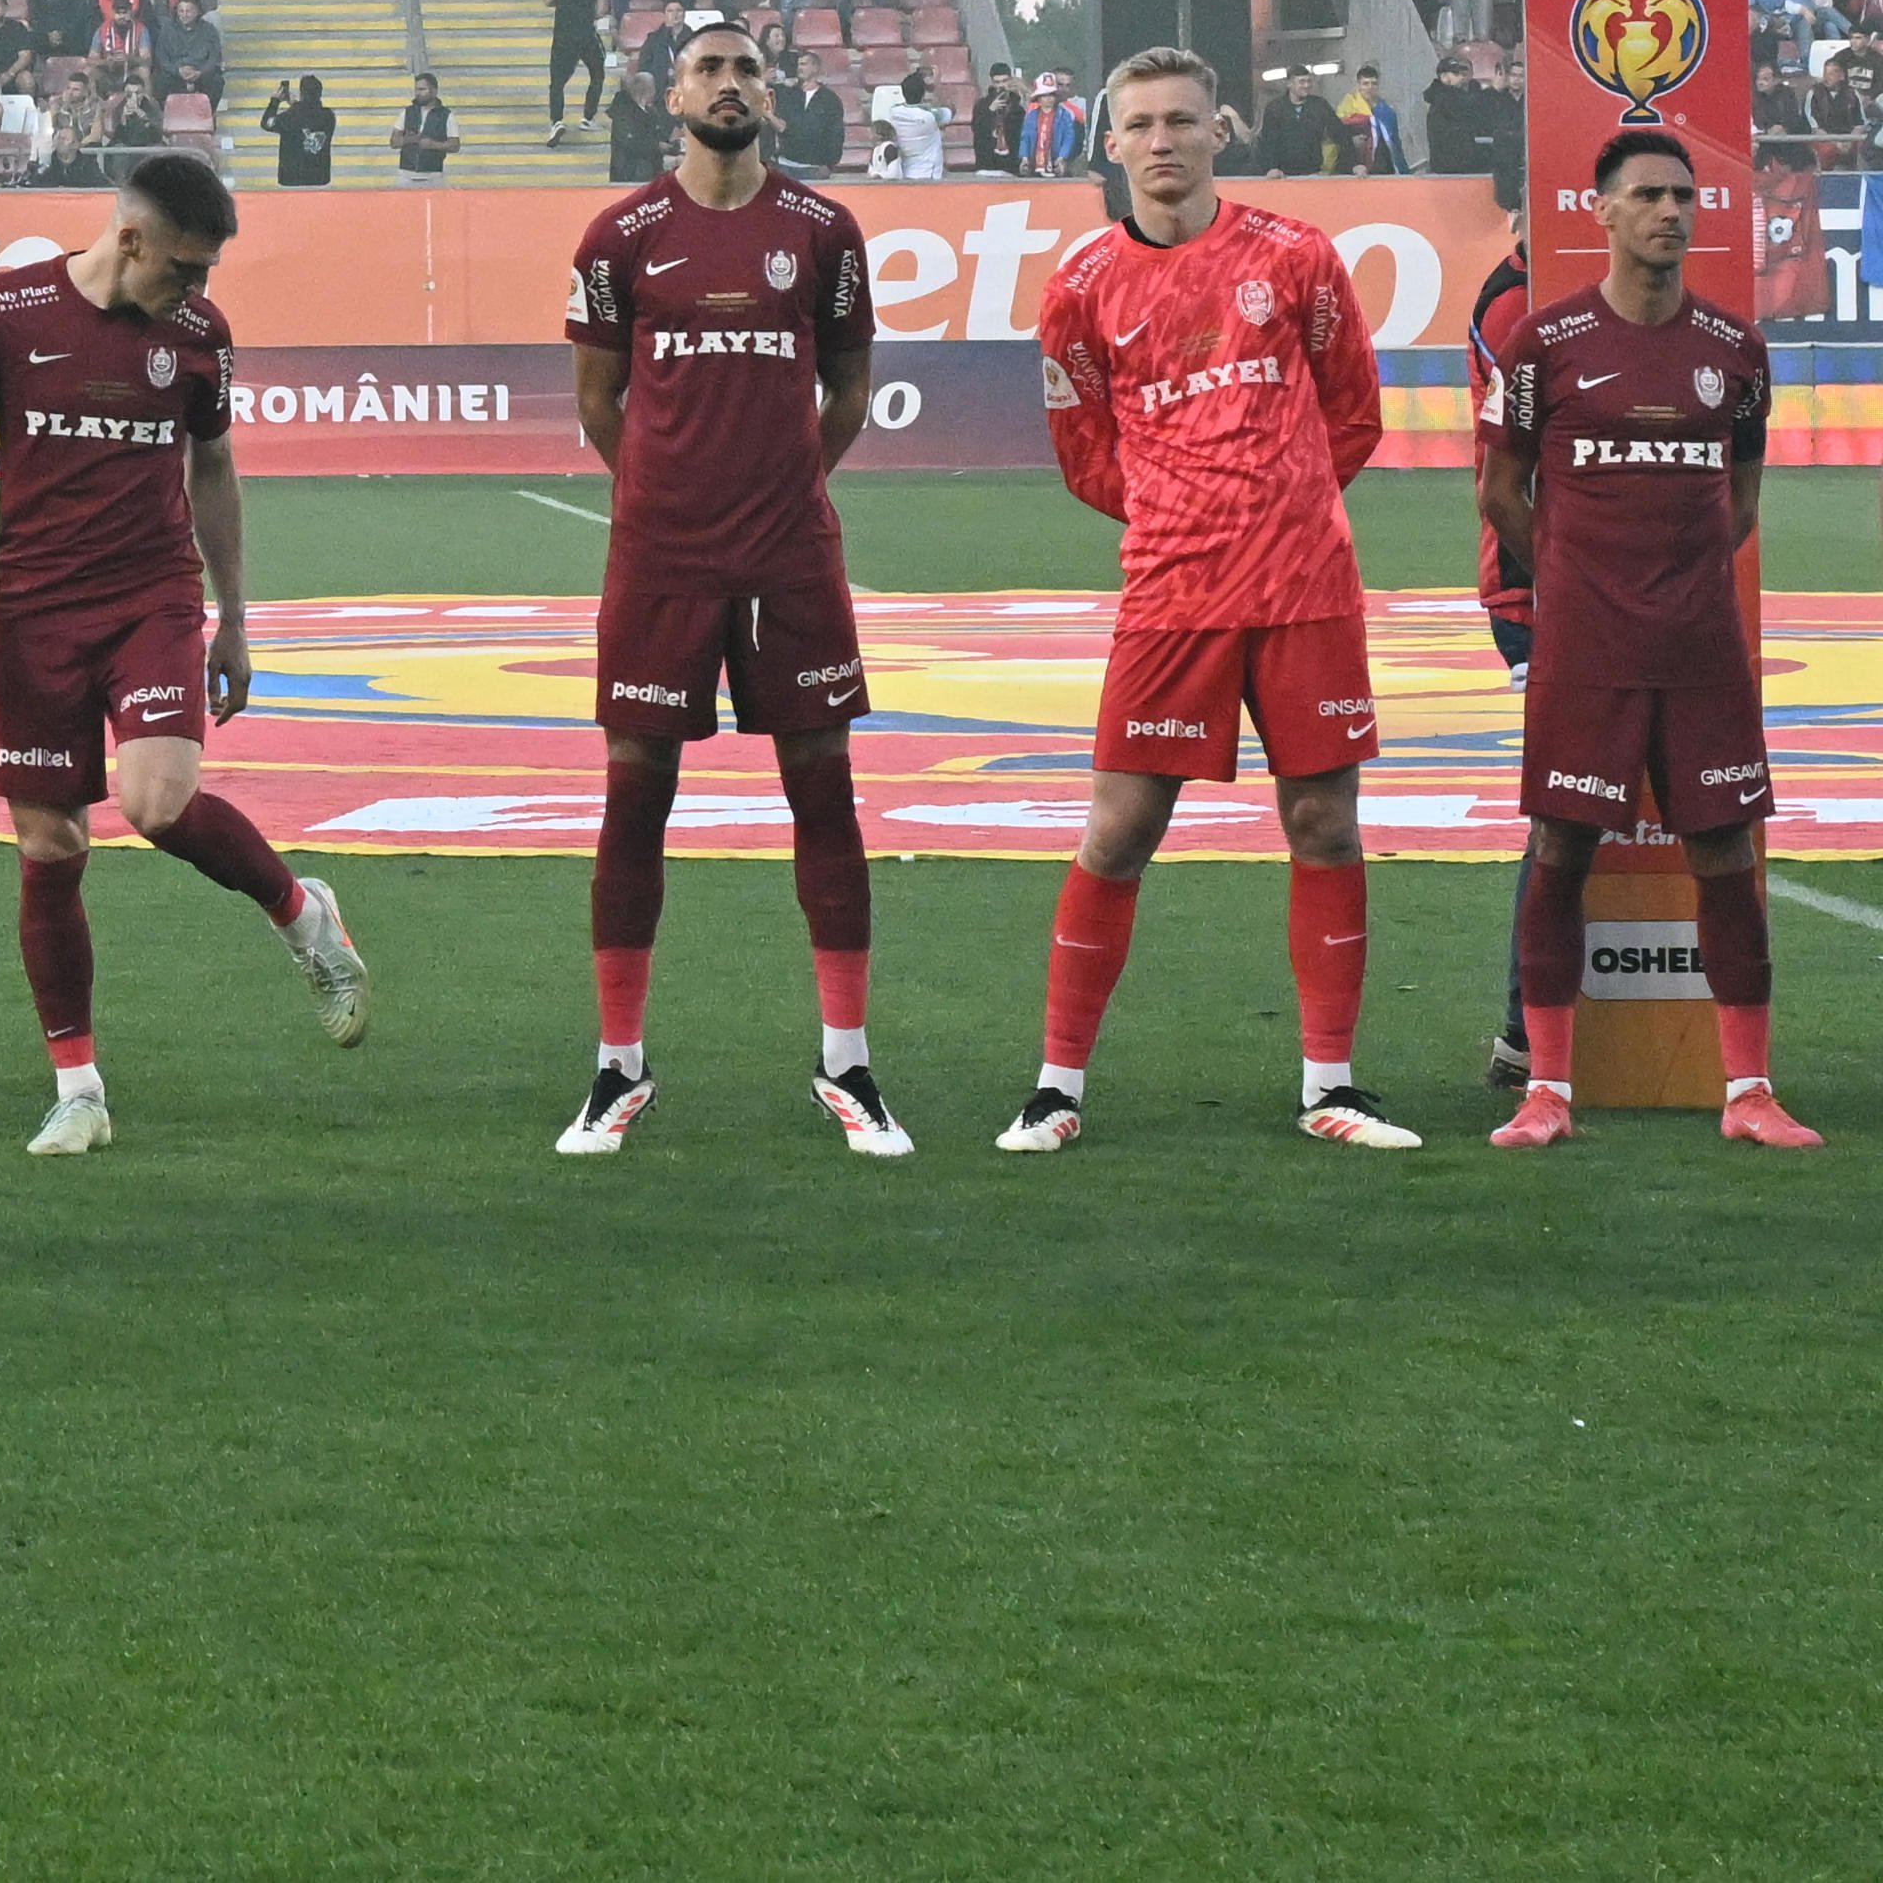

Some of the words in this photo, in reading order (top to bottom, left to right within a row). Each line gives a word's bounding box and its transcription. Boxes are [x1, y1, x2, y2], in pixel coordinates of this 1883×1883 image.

[597, 259, 619, 324] AQUAVIA
[832, 248, 854, 319] AQUAVIA
[1310, 284, 1330, 352] AQUAVIA
[653, 331, 796, 361] PLAYER
[231, 374, 510, 422] ROMÂNIEI
[1517, 363, 1537, 432] AQUAVIA
[24, 409, 176, 446] PLAYER
[1572, 437, 1725, 469] PLAYER
[611, 680, 690, 710] peditel
[1125, 718, 1208, 742] peditel
[1547, 768, 1628, 803] peditel
